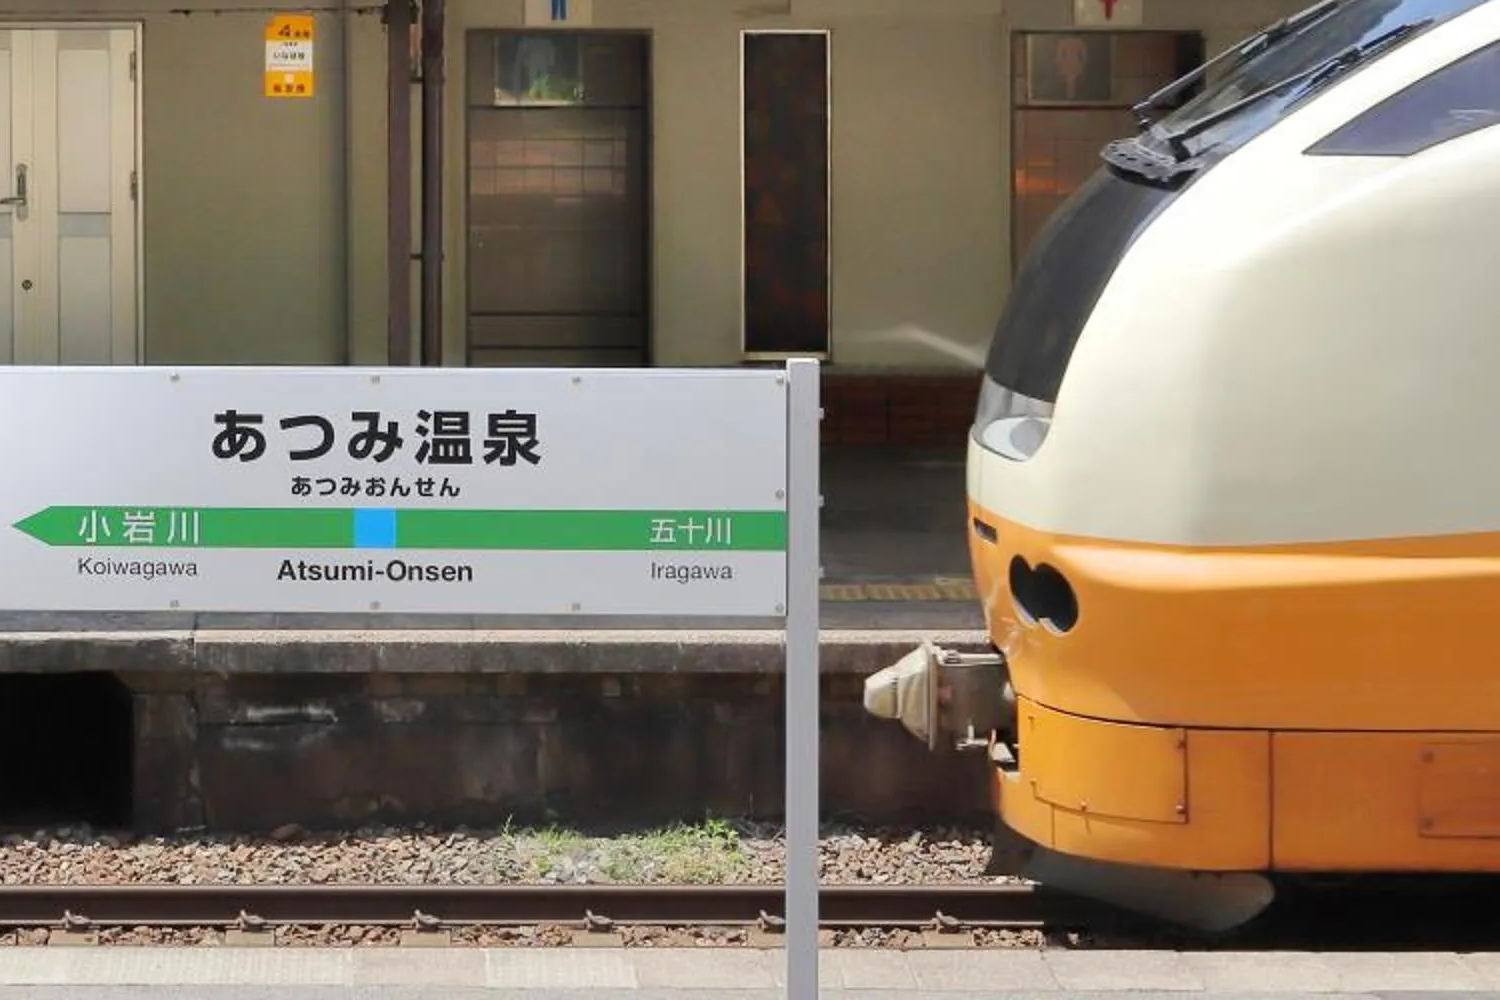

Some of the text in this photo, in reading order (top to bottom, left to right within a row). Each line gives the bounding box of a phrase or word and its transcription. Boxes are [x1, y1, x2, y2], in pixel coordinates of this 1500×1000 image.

[212, 409, 542, 466] あつみ温泉
[291, 475, 461, 497] あつみおんせん
[77, 509, 200, 545] 小岩川
[649, 516, 732, 545] 五十川
[77, 557, 199, 580] Koiwagawa
[277, 559, 474, 582] Atsumi-Onsen
[651, 561, 733, 584] Iragawa
